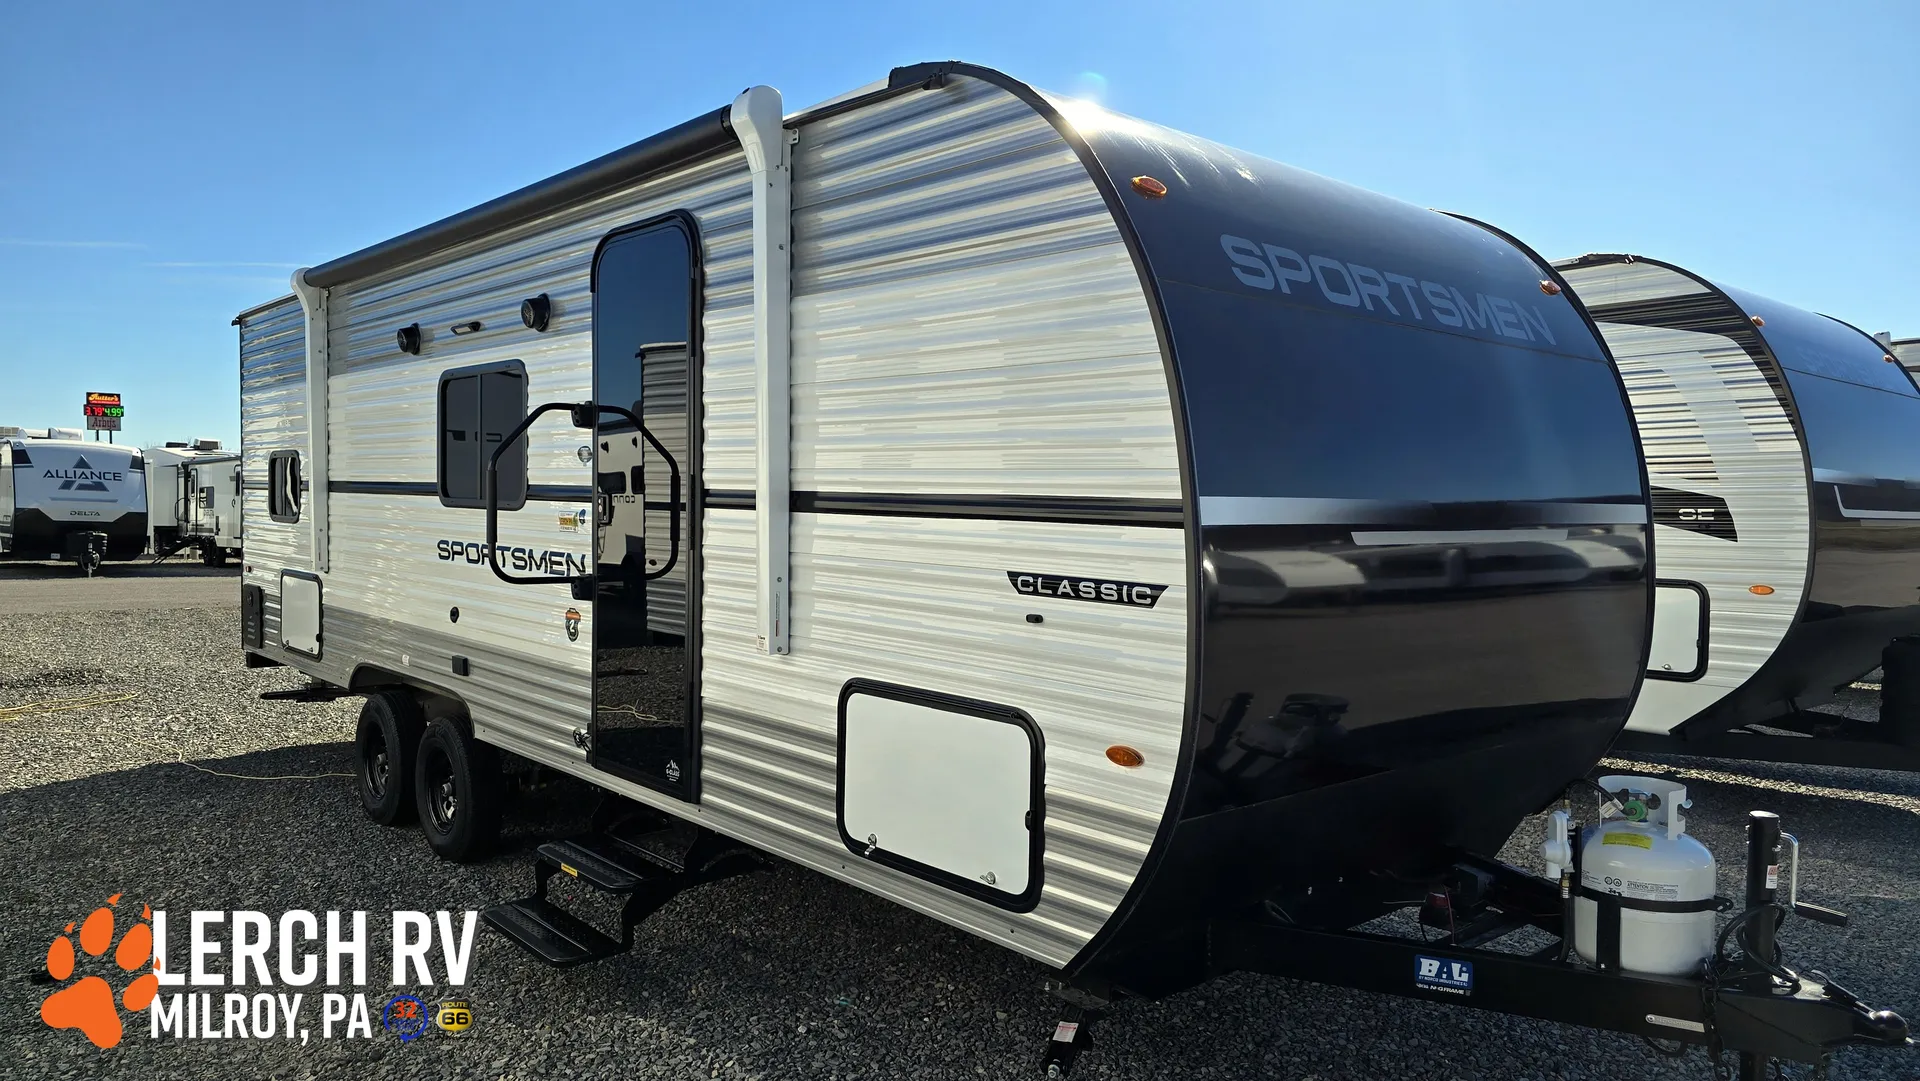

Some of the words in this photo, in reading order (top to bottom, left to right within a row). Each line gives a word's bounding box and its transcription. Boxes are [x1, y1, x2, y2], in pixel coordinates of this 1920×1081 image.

[1220, 234, 1557, 346] SPORTSMEN
[42, 469, 123, 482] ALLIANCE
[1017, 575, 1152, 605] CLASSIC
